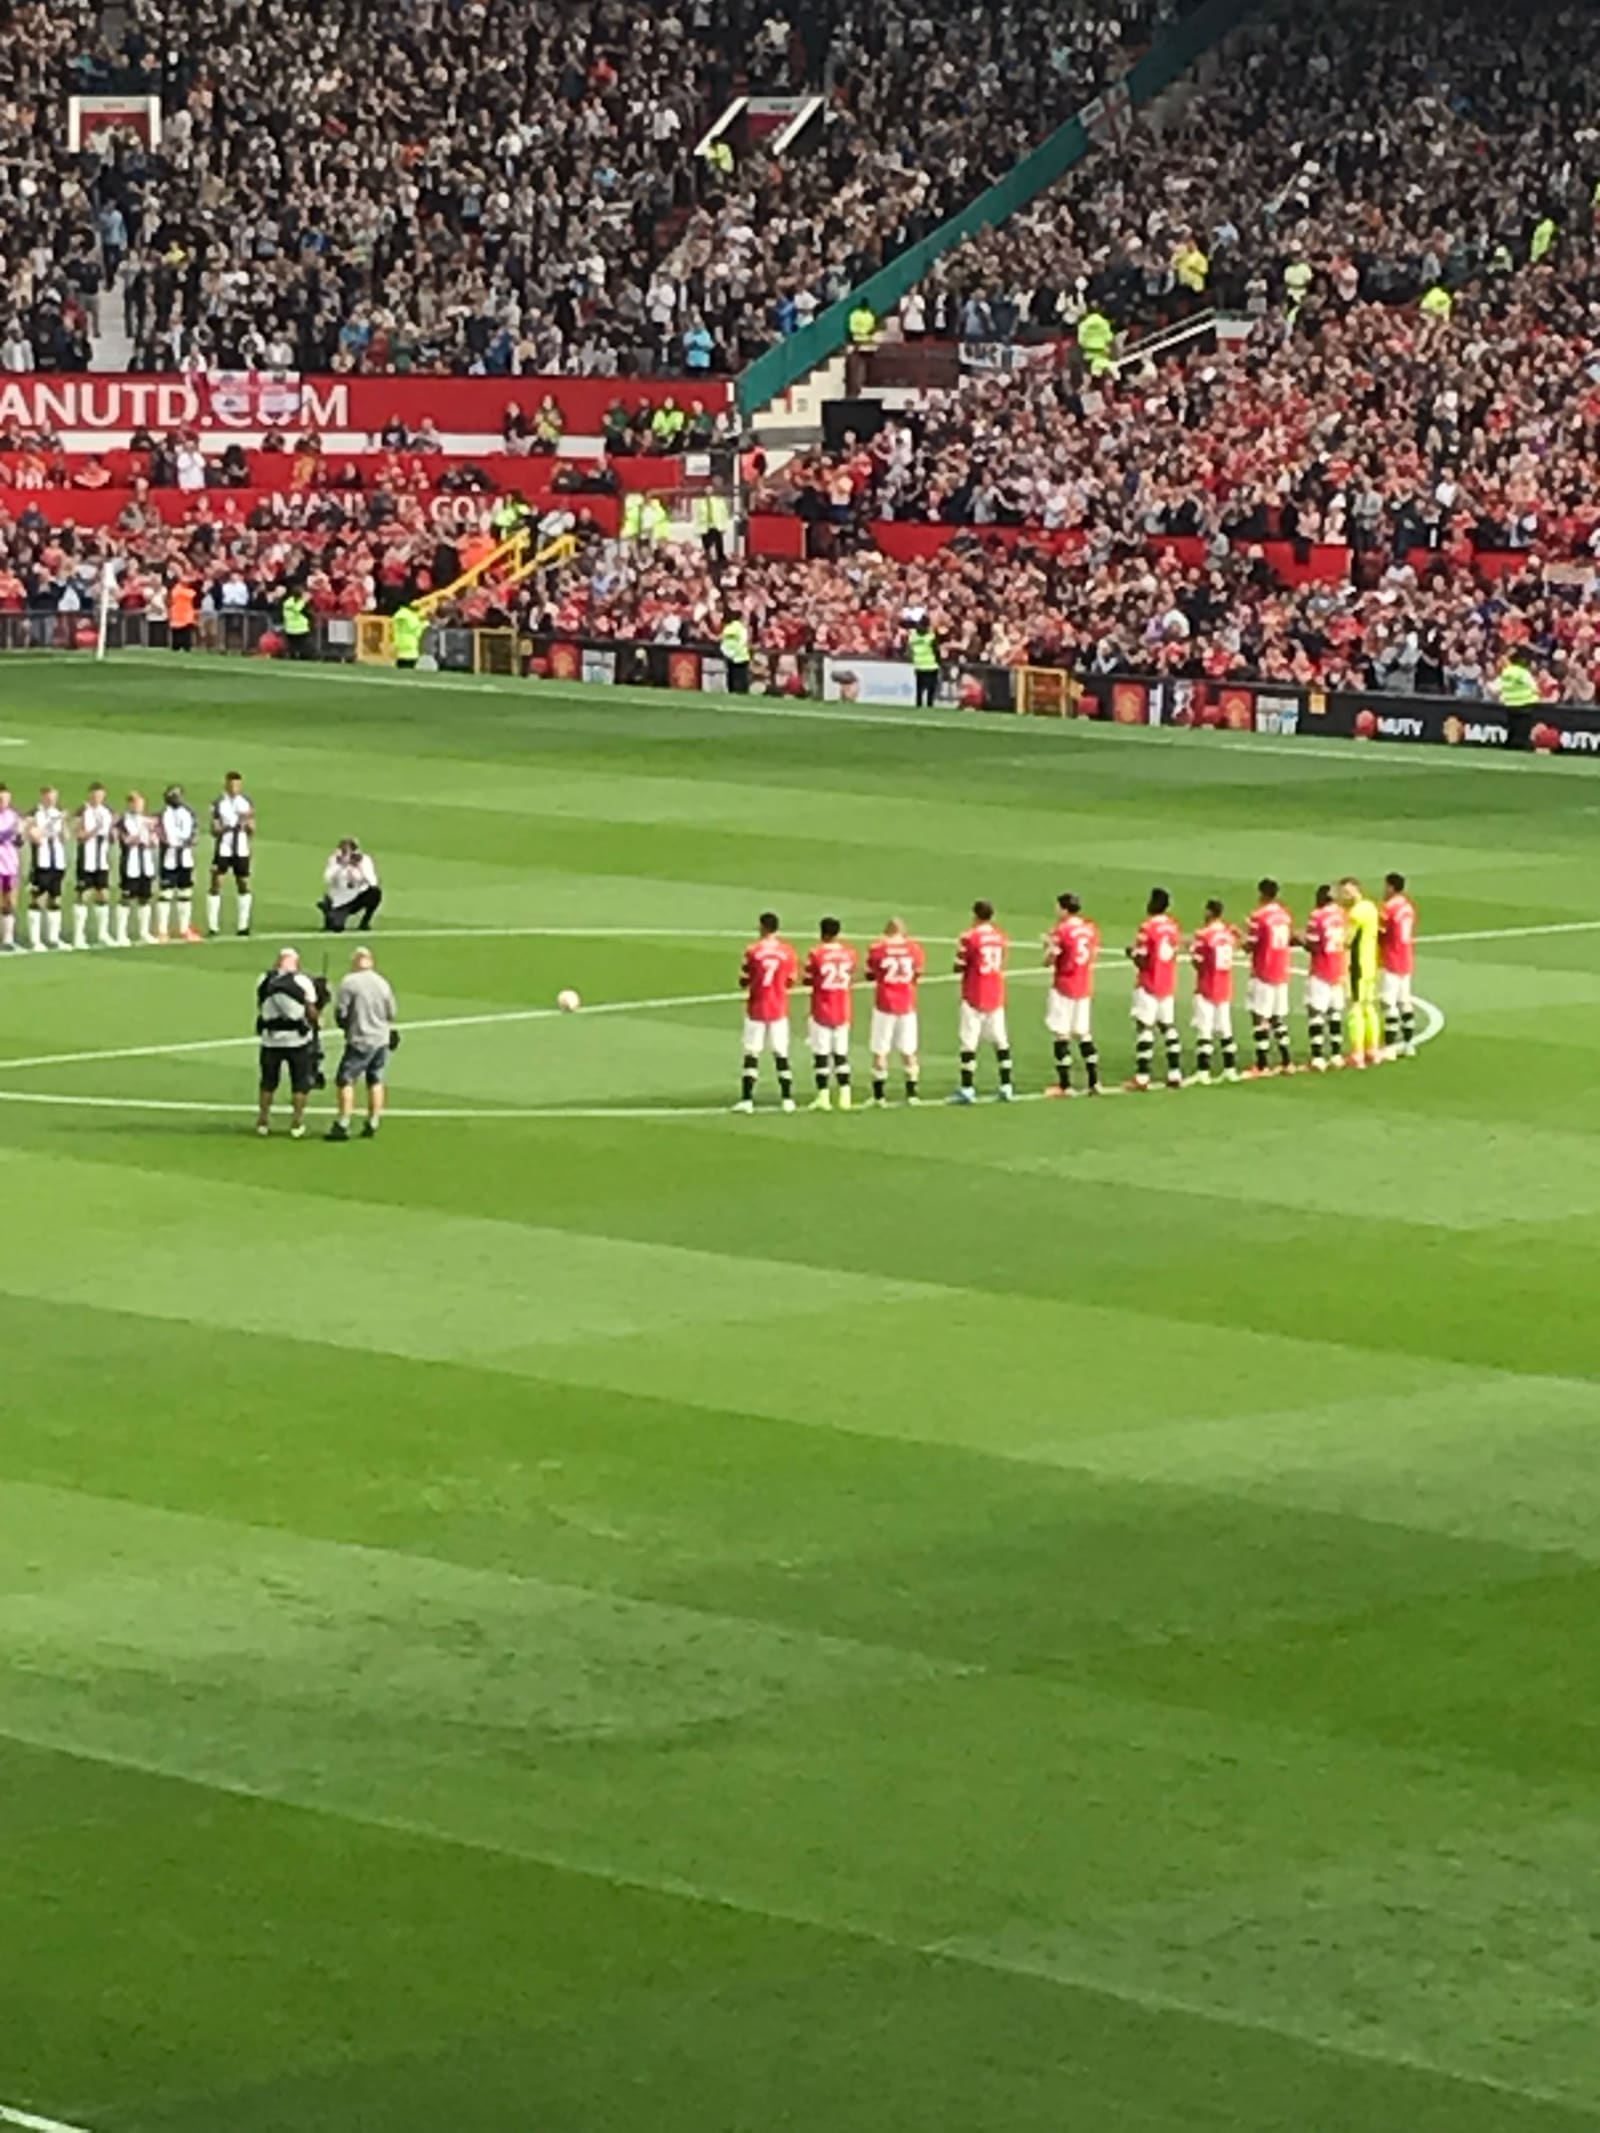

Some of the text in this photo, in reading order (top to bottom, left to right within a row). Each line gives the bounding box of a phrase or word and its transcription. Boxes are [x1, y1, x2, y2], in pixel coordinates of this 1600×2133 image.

[1075, 938, 1089, 965] 5
[762, 959, 780, 987] 7
[820, 963, 850, 990] 25
[880, 956, 913, 984] 23
